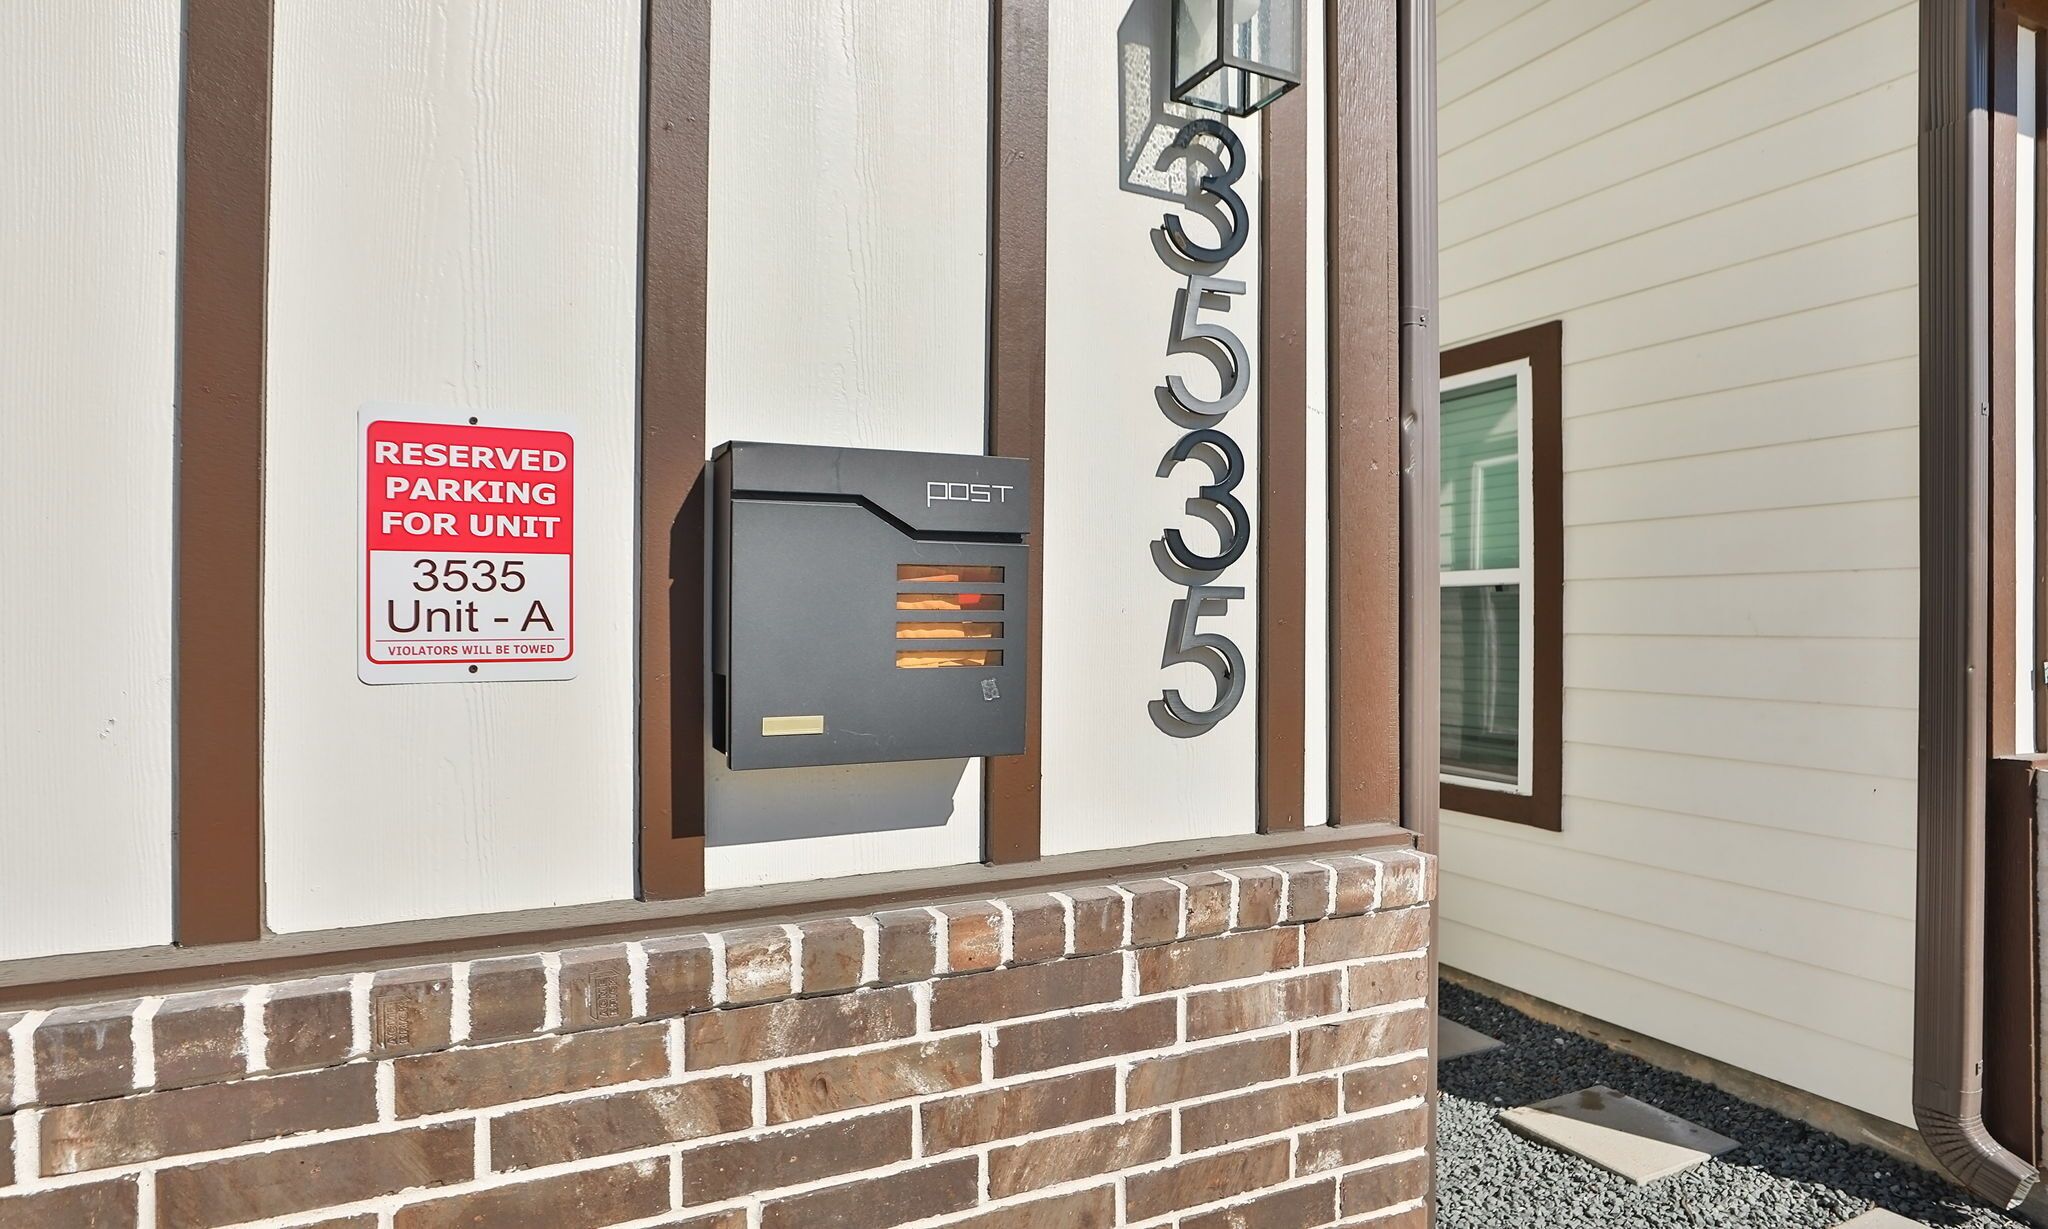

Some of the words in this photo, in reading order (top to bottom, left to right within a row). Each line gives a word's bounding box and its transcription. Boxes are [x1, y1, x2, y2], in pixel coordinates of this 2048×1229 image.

[1162, 118, 1250, 725] 3535
[375, 440, 567, 472] RESERVED
[386, 476, 556, 505] PARKING
[381, 511, 459, 536] FOR
[469, 514, 561, 538] UNIT
[412, 558, 526, 592] 3535
[387, 599, 479, 633] Unit
[520, 599, 555, 632] A
[388, 645, 458, 656] VIOLATORS
[461, 645, 492, 655] WILL
[495, 644, 510, 654] BE
[513, 644, 555, 654] TOWED
